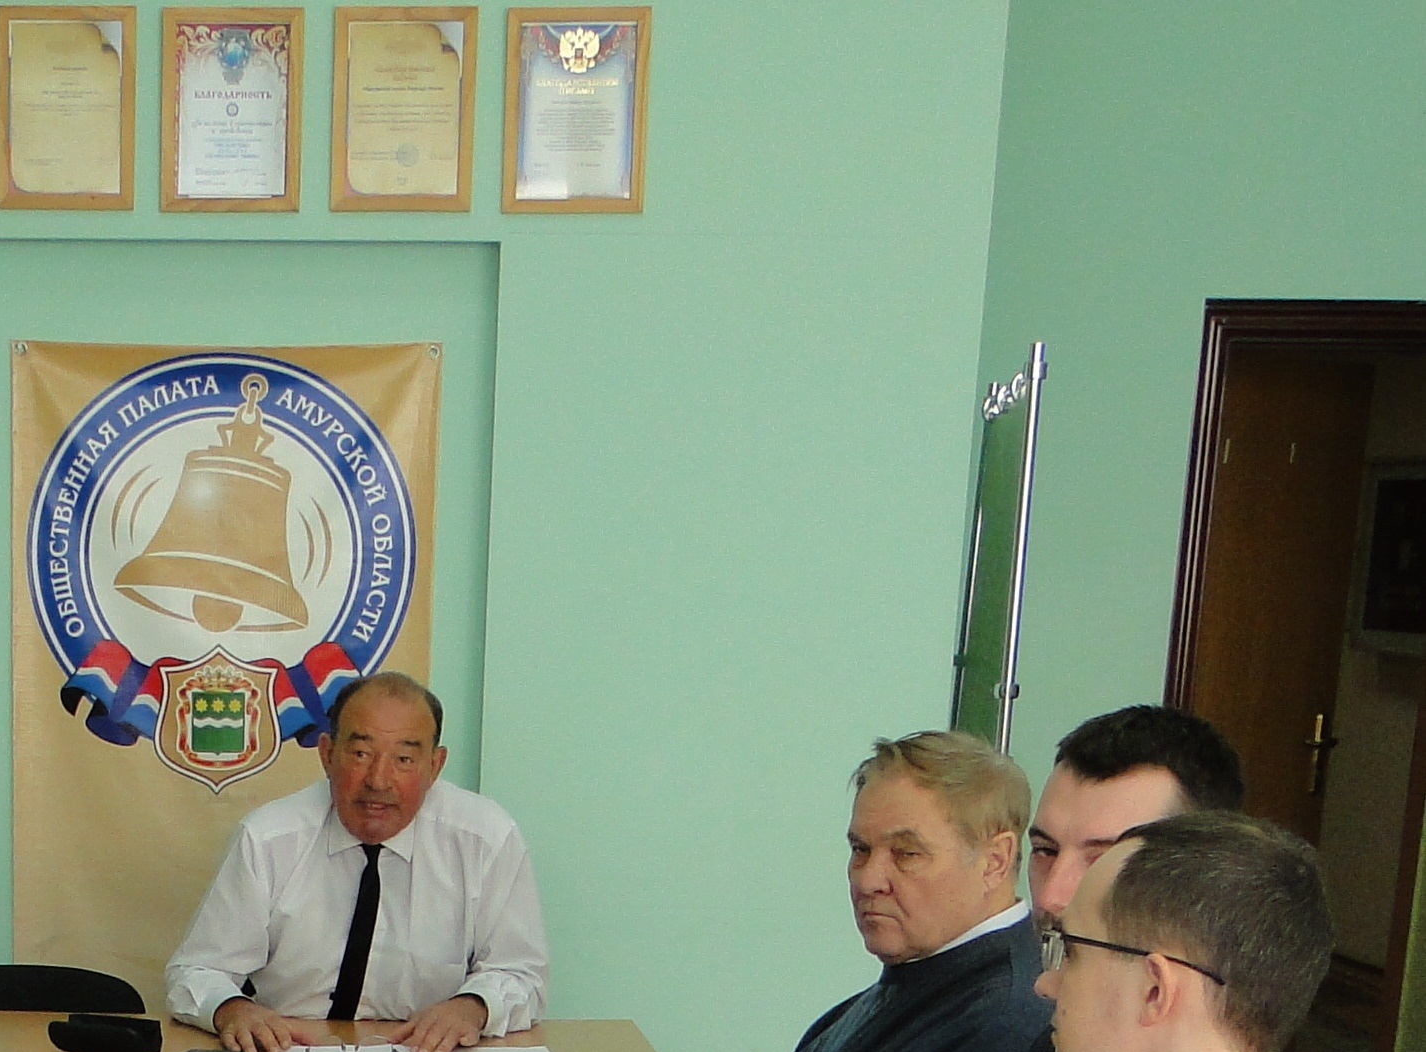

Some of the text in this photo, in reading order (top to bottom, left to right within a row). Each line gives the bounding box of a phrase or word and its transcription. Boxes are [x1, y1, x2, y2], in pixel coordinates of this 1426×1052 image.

[194, 90, 272, 100] БЛАГОДАРНОСТЬ
[48, 375, 393, 644] ОБЩЕСТВЕННАЯ ПАЛАТА АМУРСКОЙ ОБЛАСТИ
